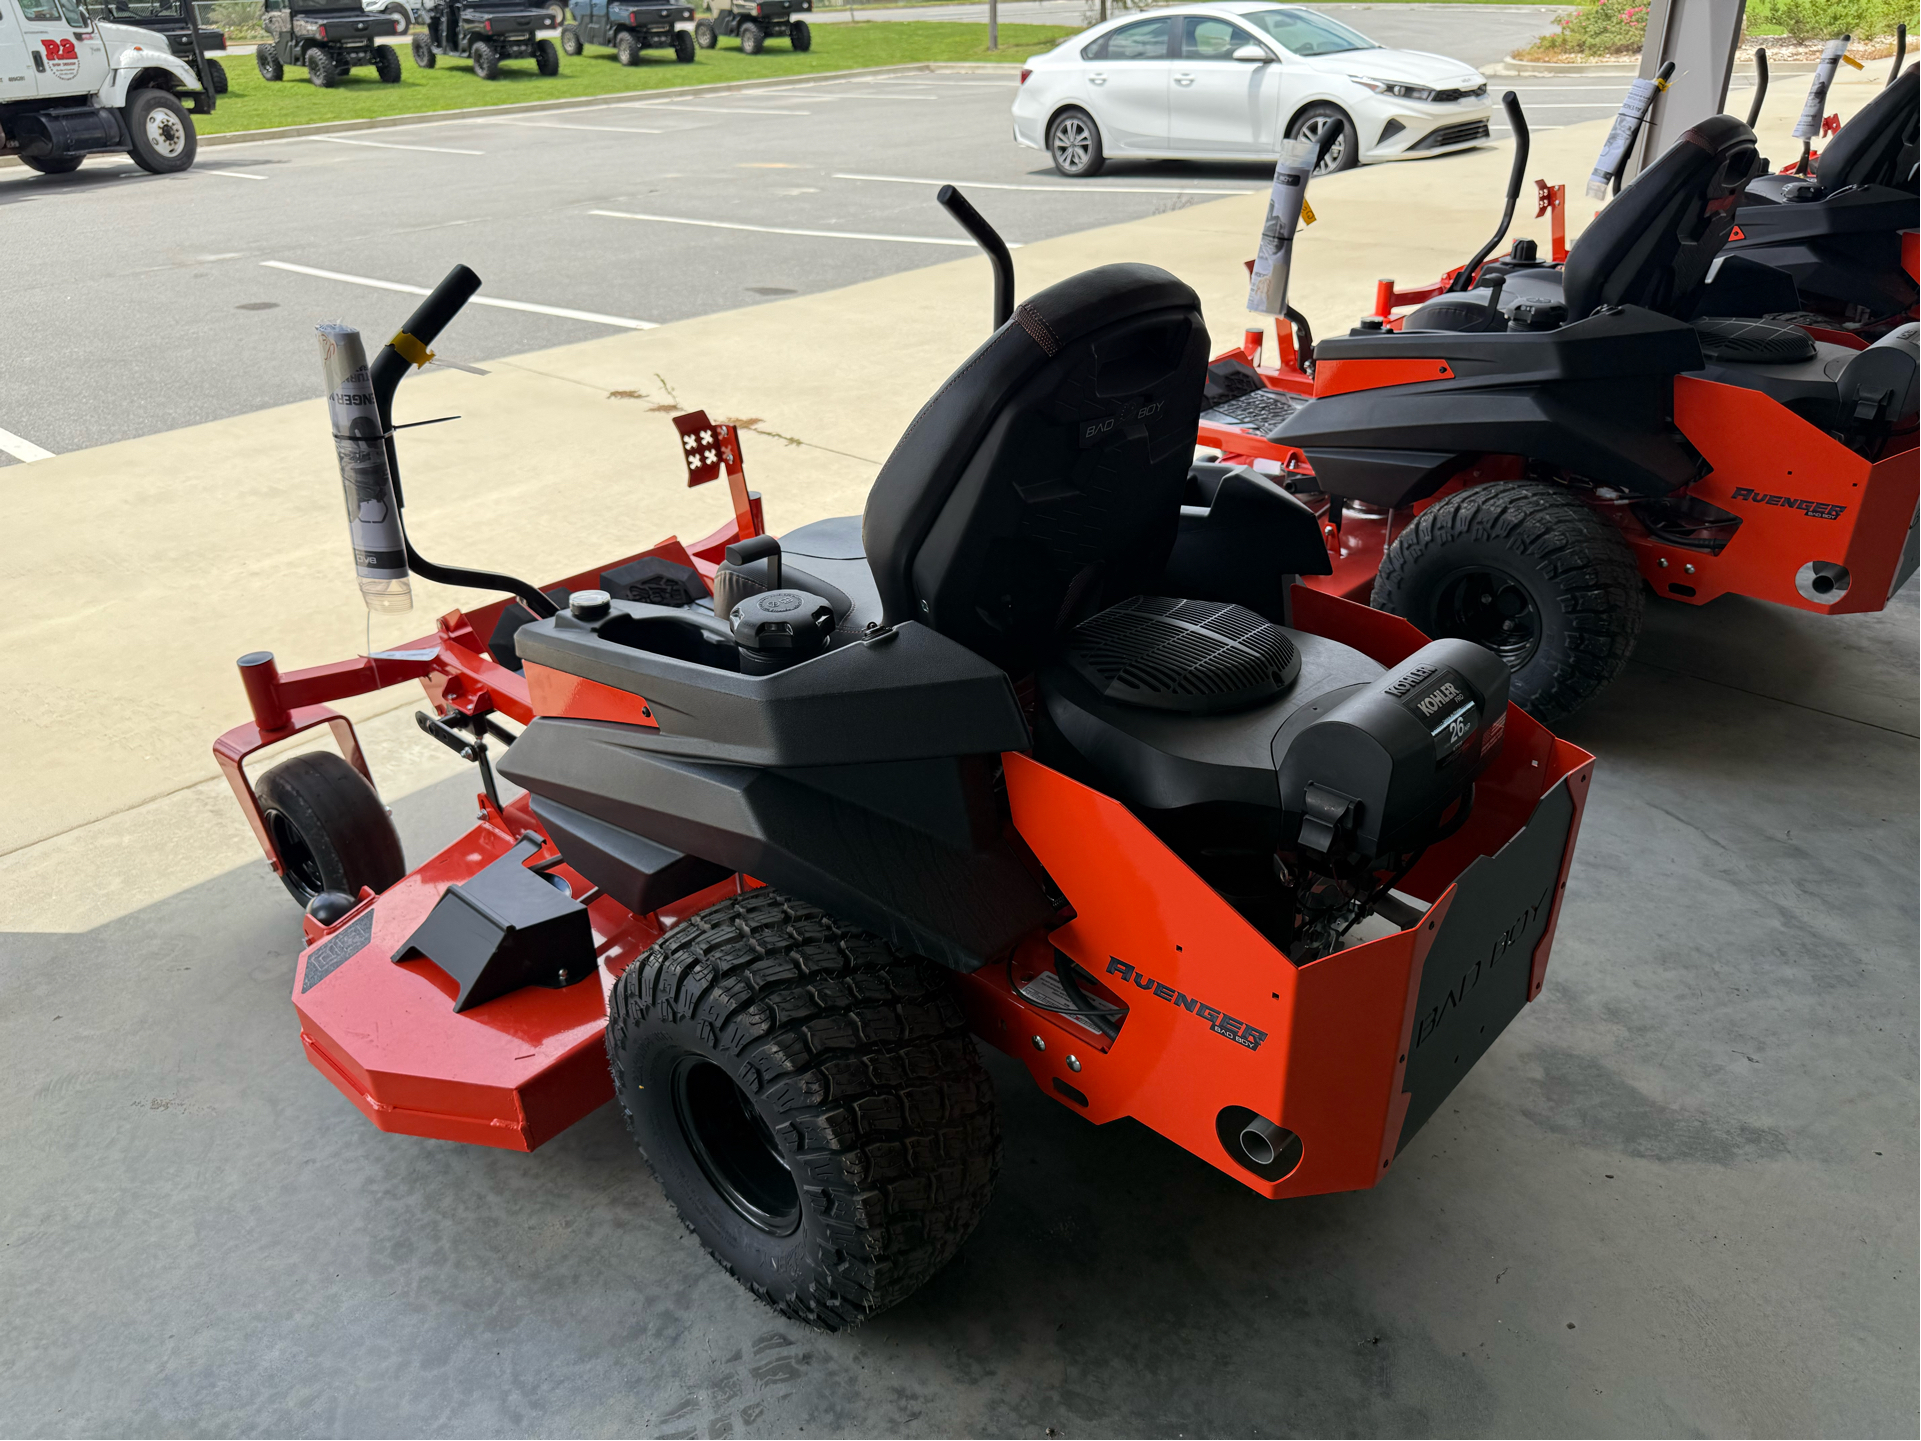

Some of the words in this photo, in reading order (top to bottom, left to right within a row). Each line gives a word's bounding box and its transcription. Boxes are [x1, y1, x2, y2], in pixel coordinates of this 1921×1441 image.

[41, 38, 78, 61] R2
[1086, 418, 1115, 438] BAD
[1138, 400, 1165, 419] BOY
[1730, 486, 1848, 517] AVENGER
[1384, 664, 1438, 698] KOHLER
[1417, 682, 1461, 717] KOHLER
[1449, 716, 1464, 743] 26
[1105, 955, 1269, 1046] AVENGER
[1213, 1025, 1234, 1040] BAD
[1235, 1035, 1256, 1049] BOY
